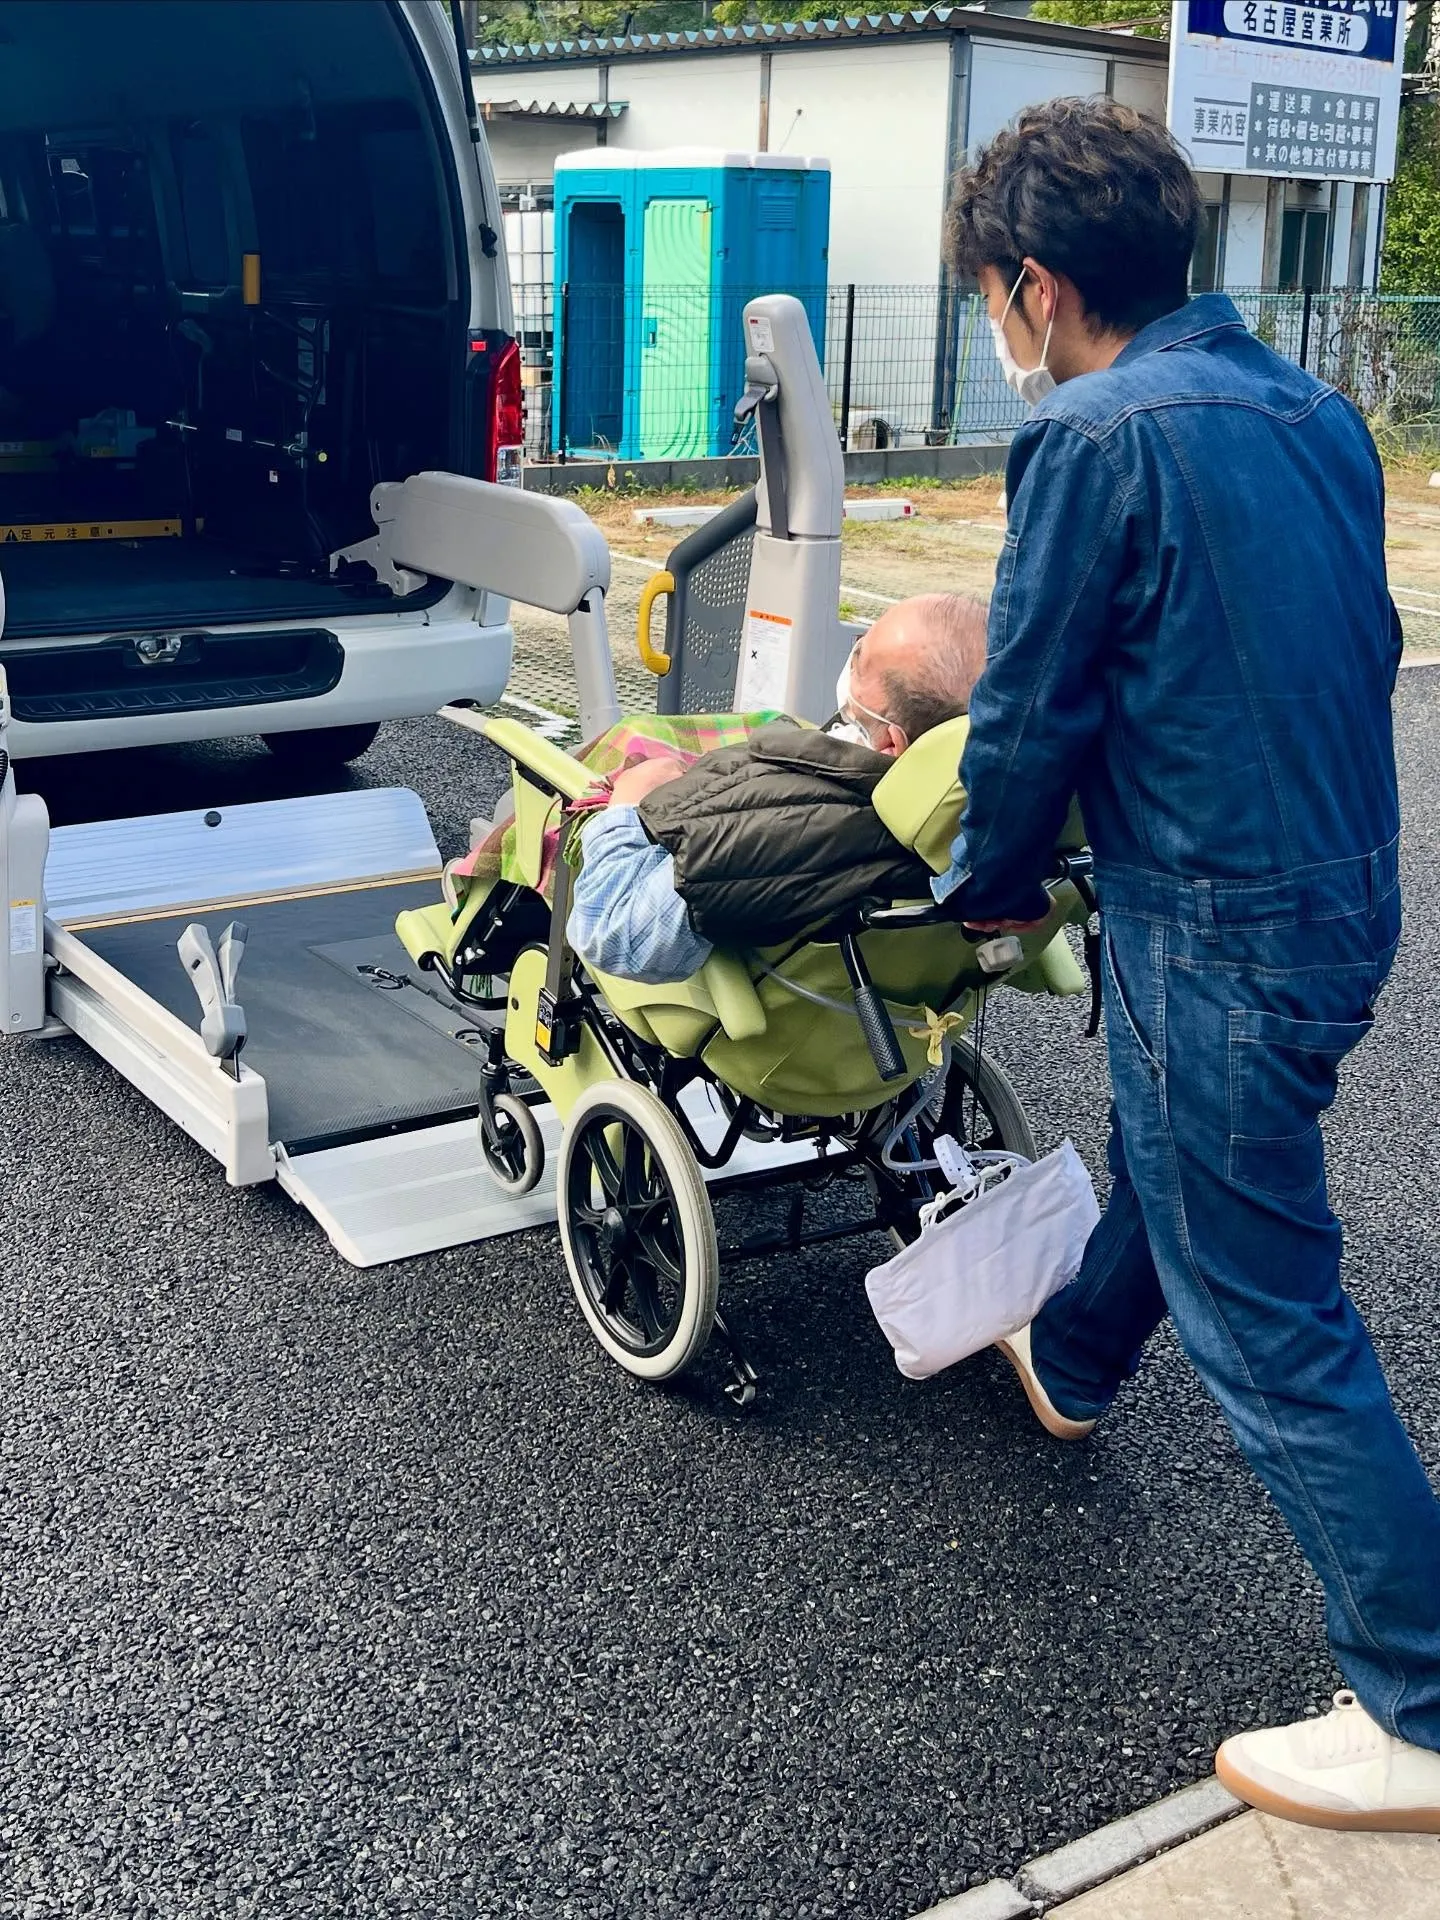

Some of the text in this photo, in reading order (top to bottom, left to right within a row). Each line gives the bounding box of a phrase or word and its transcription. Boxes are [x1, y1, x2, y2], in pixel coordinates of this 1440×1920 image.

[1243, 1, 1352, 47] 名古屋営業所
[1194, 106, 1247, 137] 事業内容
